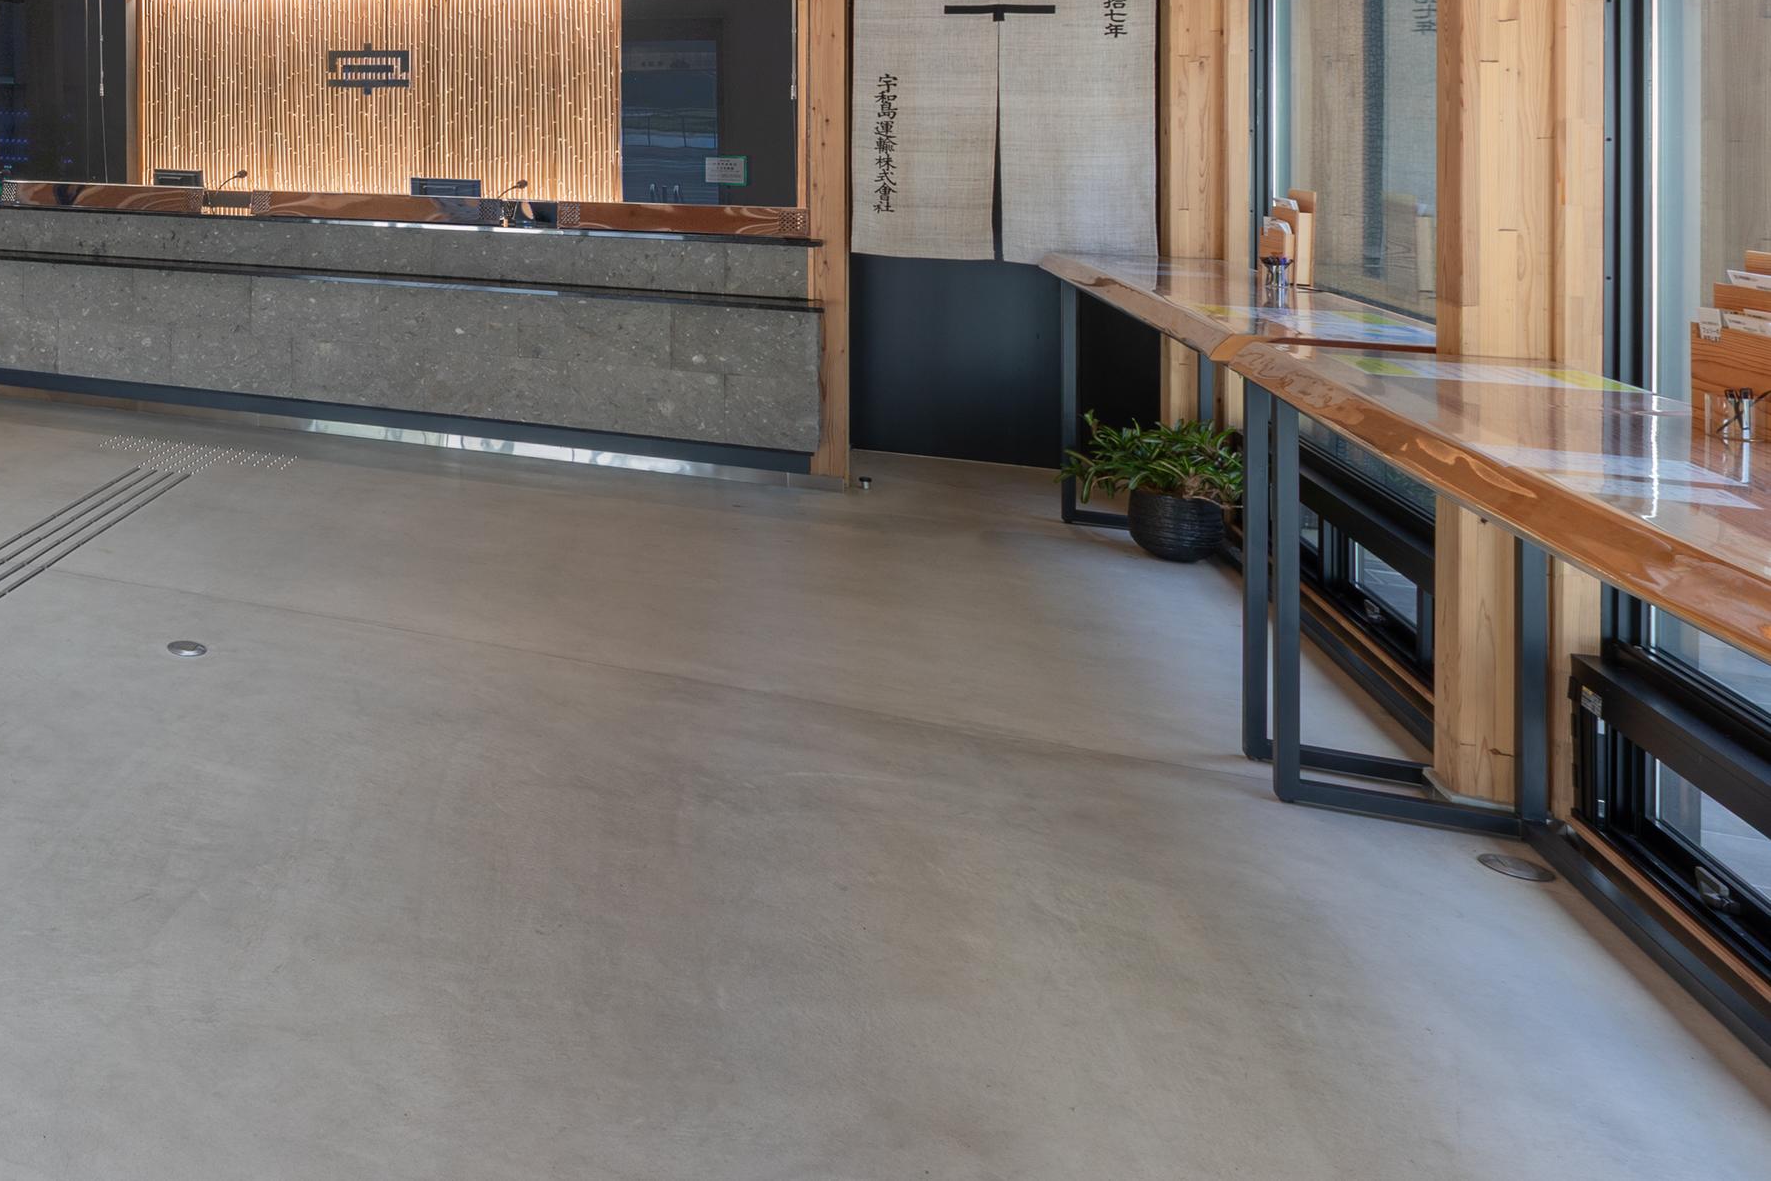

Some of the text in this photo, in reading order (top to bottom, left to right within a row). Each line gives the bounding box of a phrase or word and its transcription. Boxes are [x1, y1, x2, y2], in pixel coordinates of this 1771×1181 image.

[873, 73, 898, 214] 宇和島運輸株式會社
